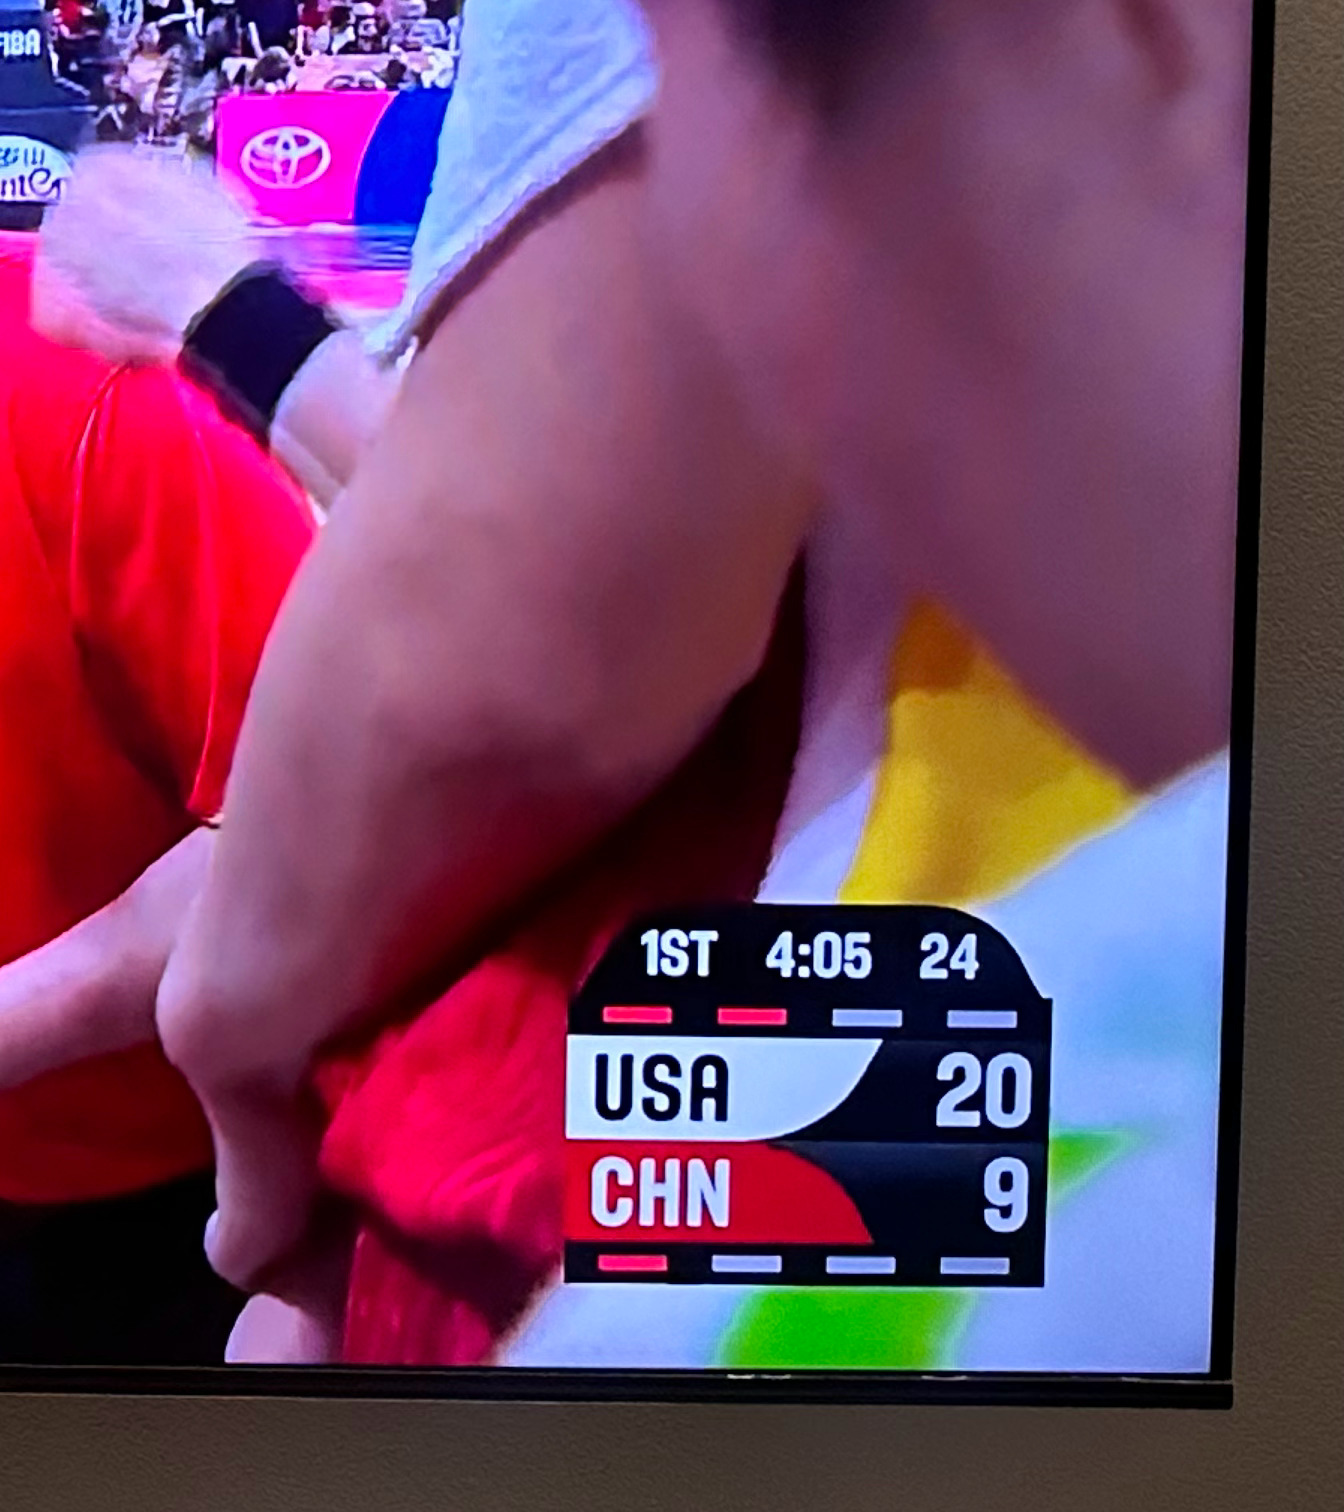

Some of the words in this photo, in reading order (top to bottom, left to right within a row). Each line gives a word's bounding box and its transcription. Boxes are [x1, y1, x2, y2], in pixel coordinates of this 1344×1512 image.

[640, 928, 719, 977] 1ST
[764, 930, 873, 979] 4:05
[918, 932, 980, 980] 24
[594, 1053, 730, 1123] USA
[935, 1051, 1033, 1128] 20
[589, 1155, 732, 1229] CHN
[982, 1156, 1030, 1233] 9
